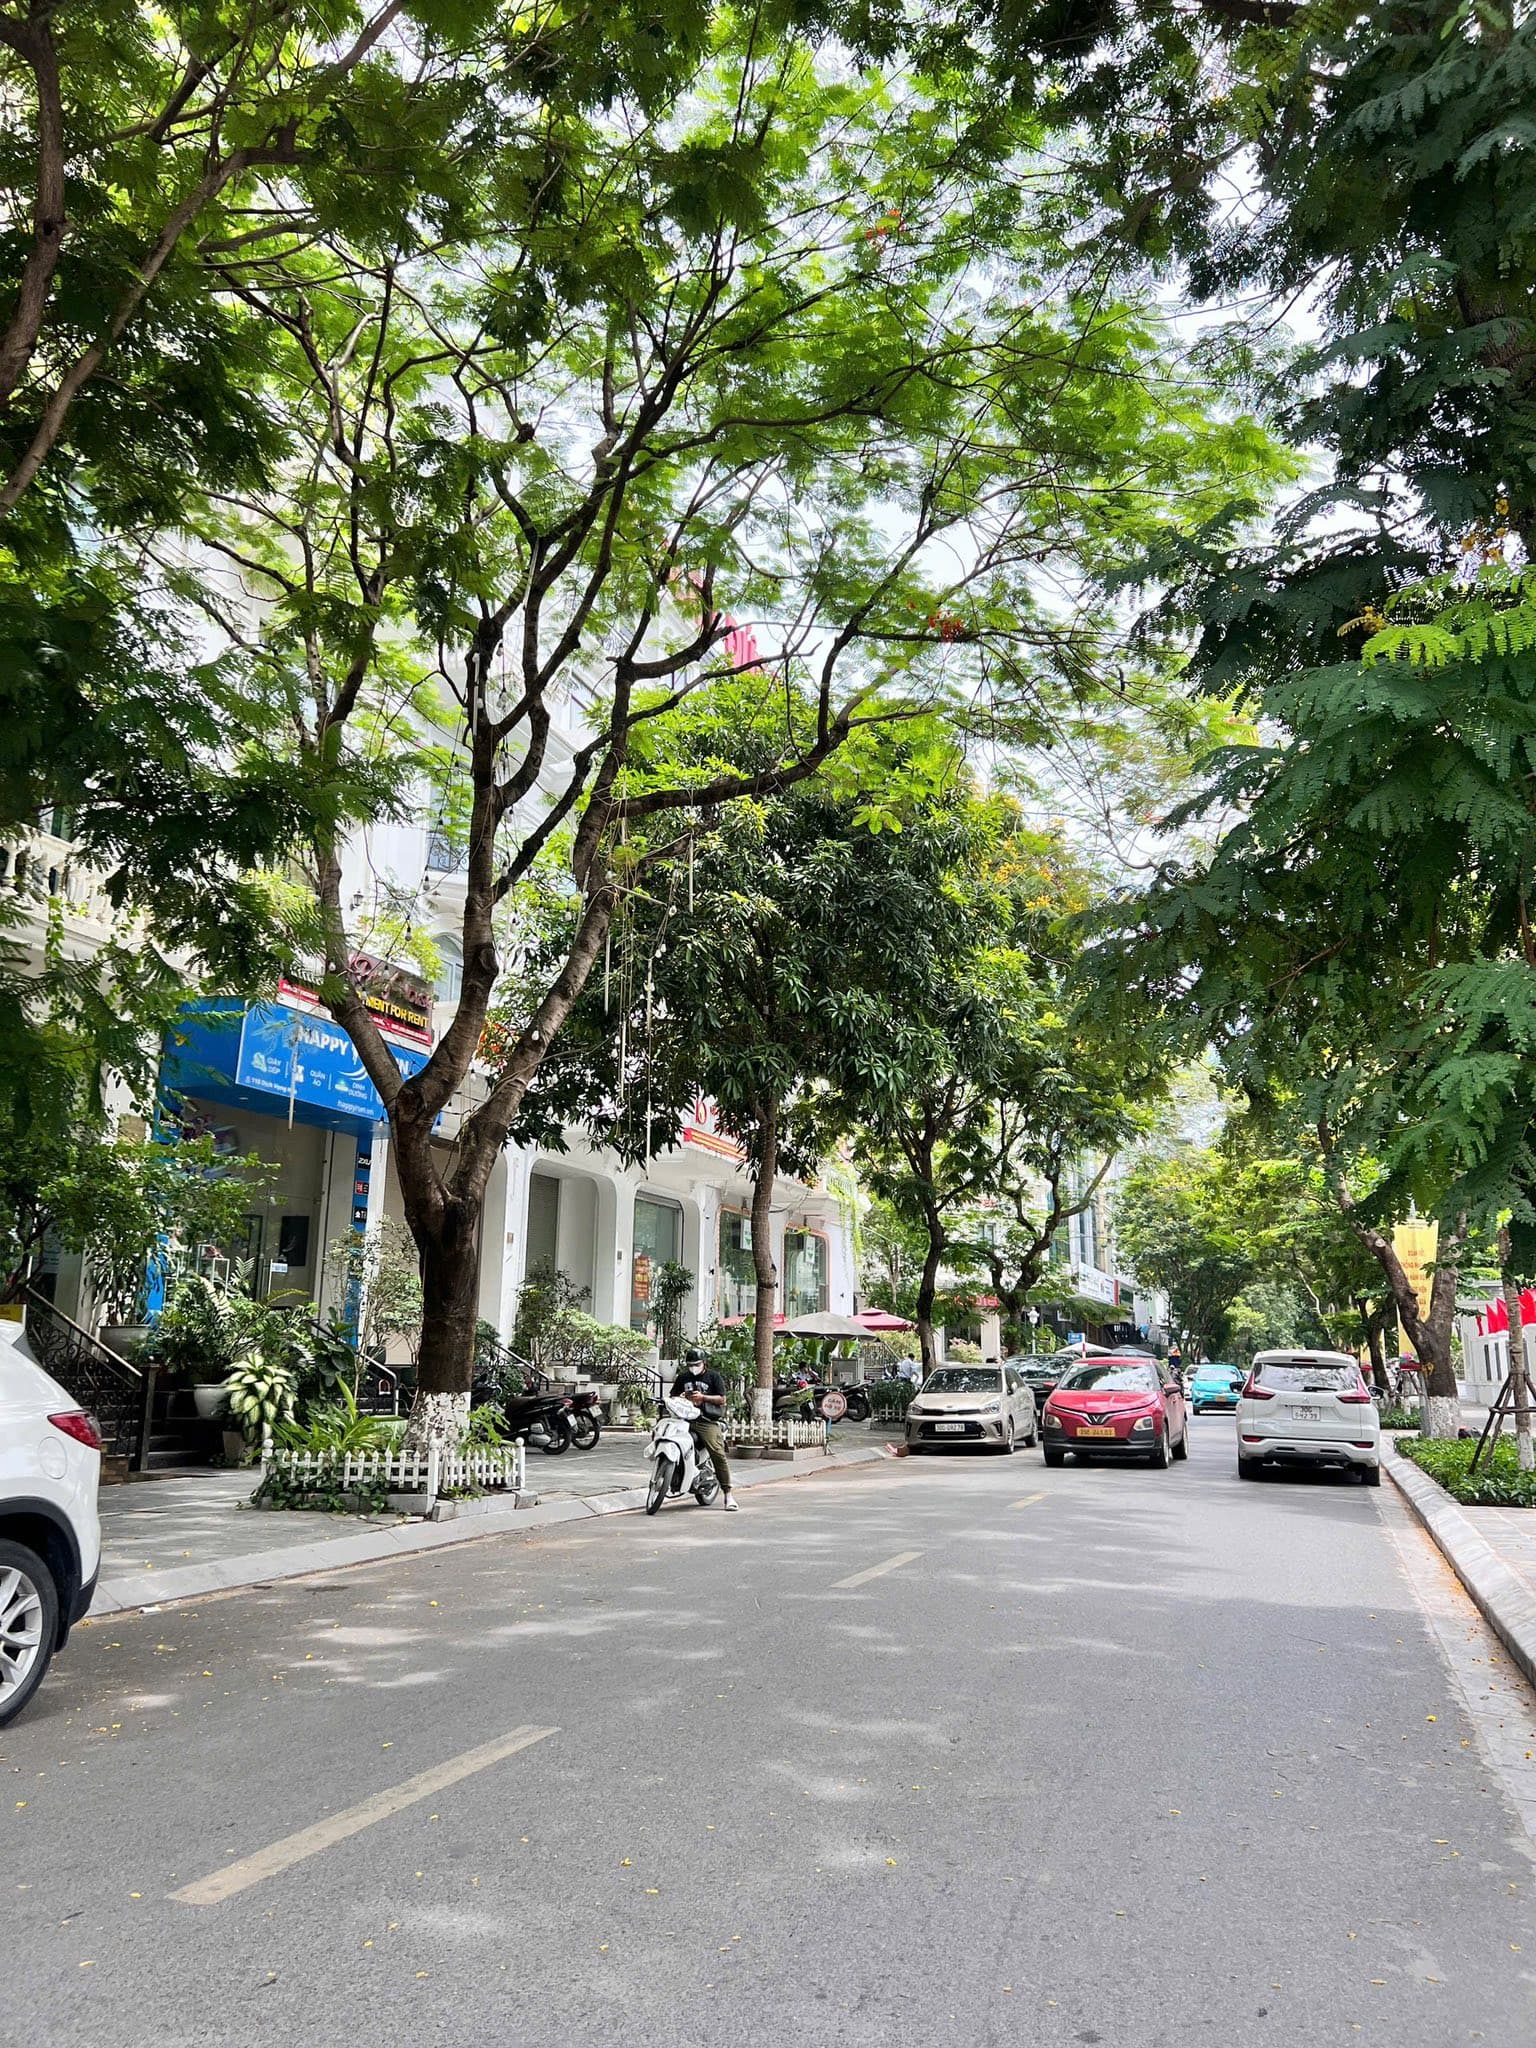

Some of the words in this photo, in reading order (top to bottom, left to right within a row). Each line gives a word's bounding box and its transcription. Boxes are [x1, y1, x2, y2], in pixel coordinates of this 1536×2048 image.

[391, 1004, 407, 1021] FOR
[407, 1012, 430, 1028] RENT
[297, 1025, 349, 1056] HAPPY
